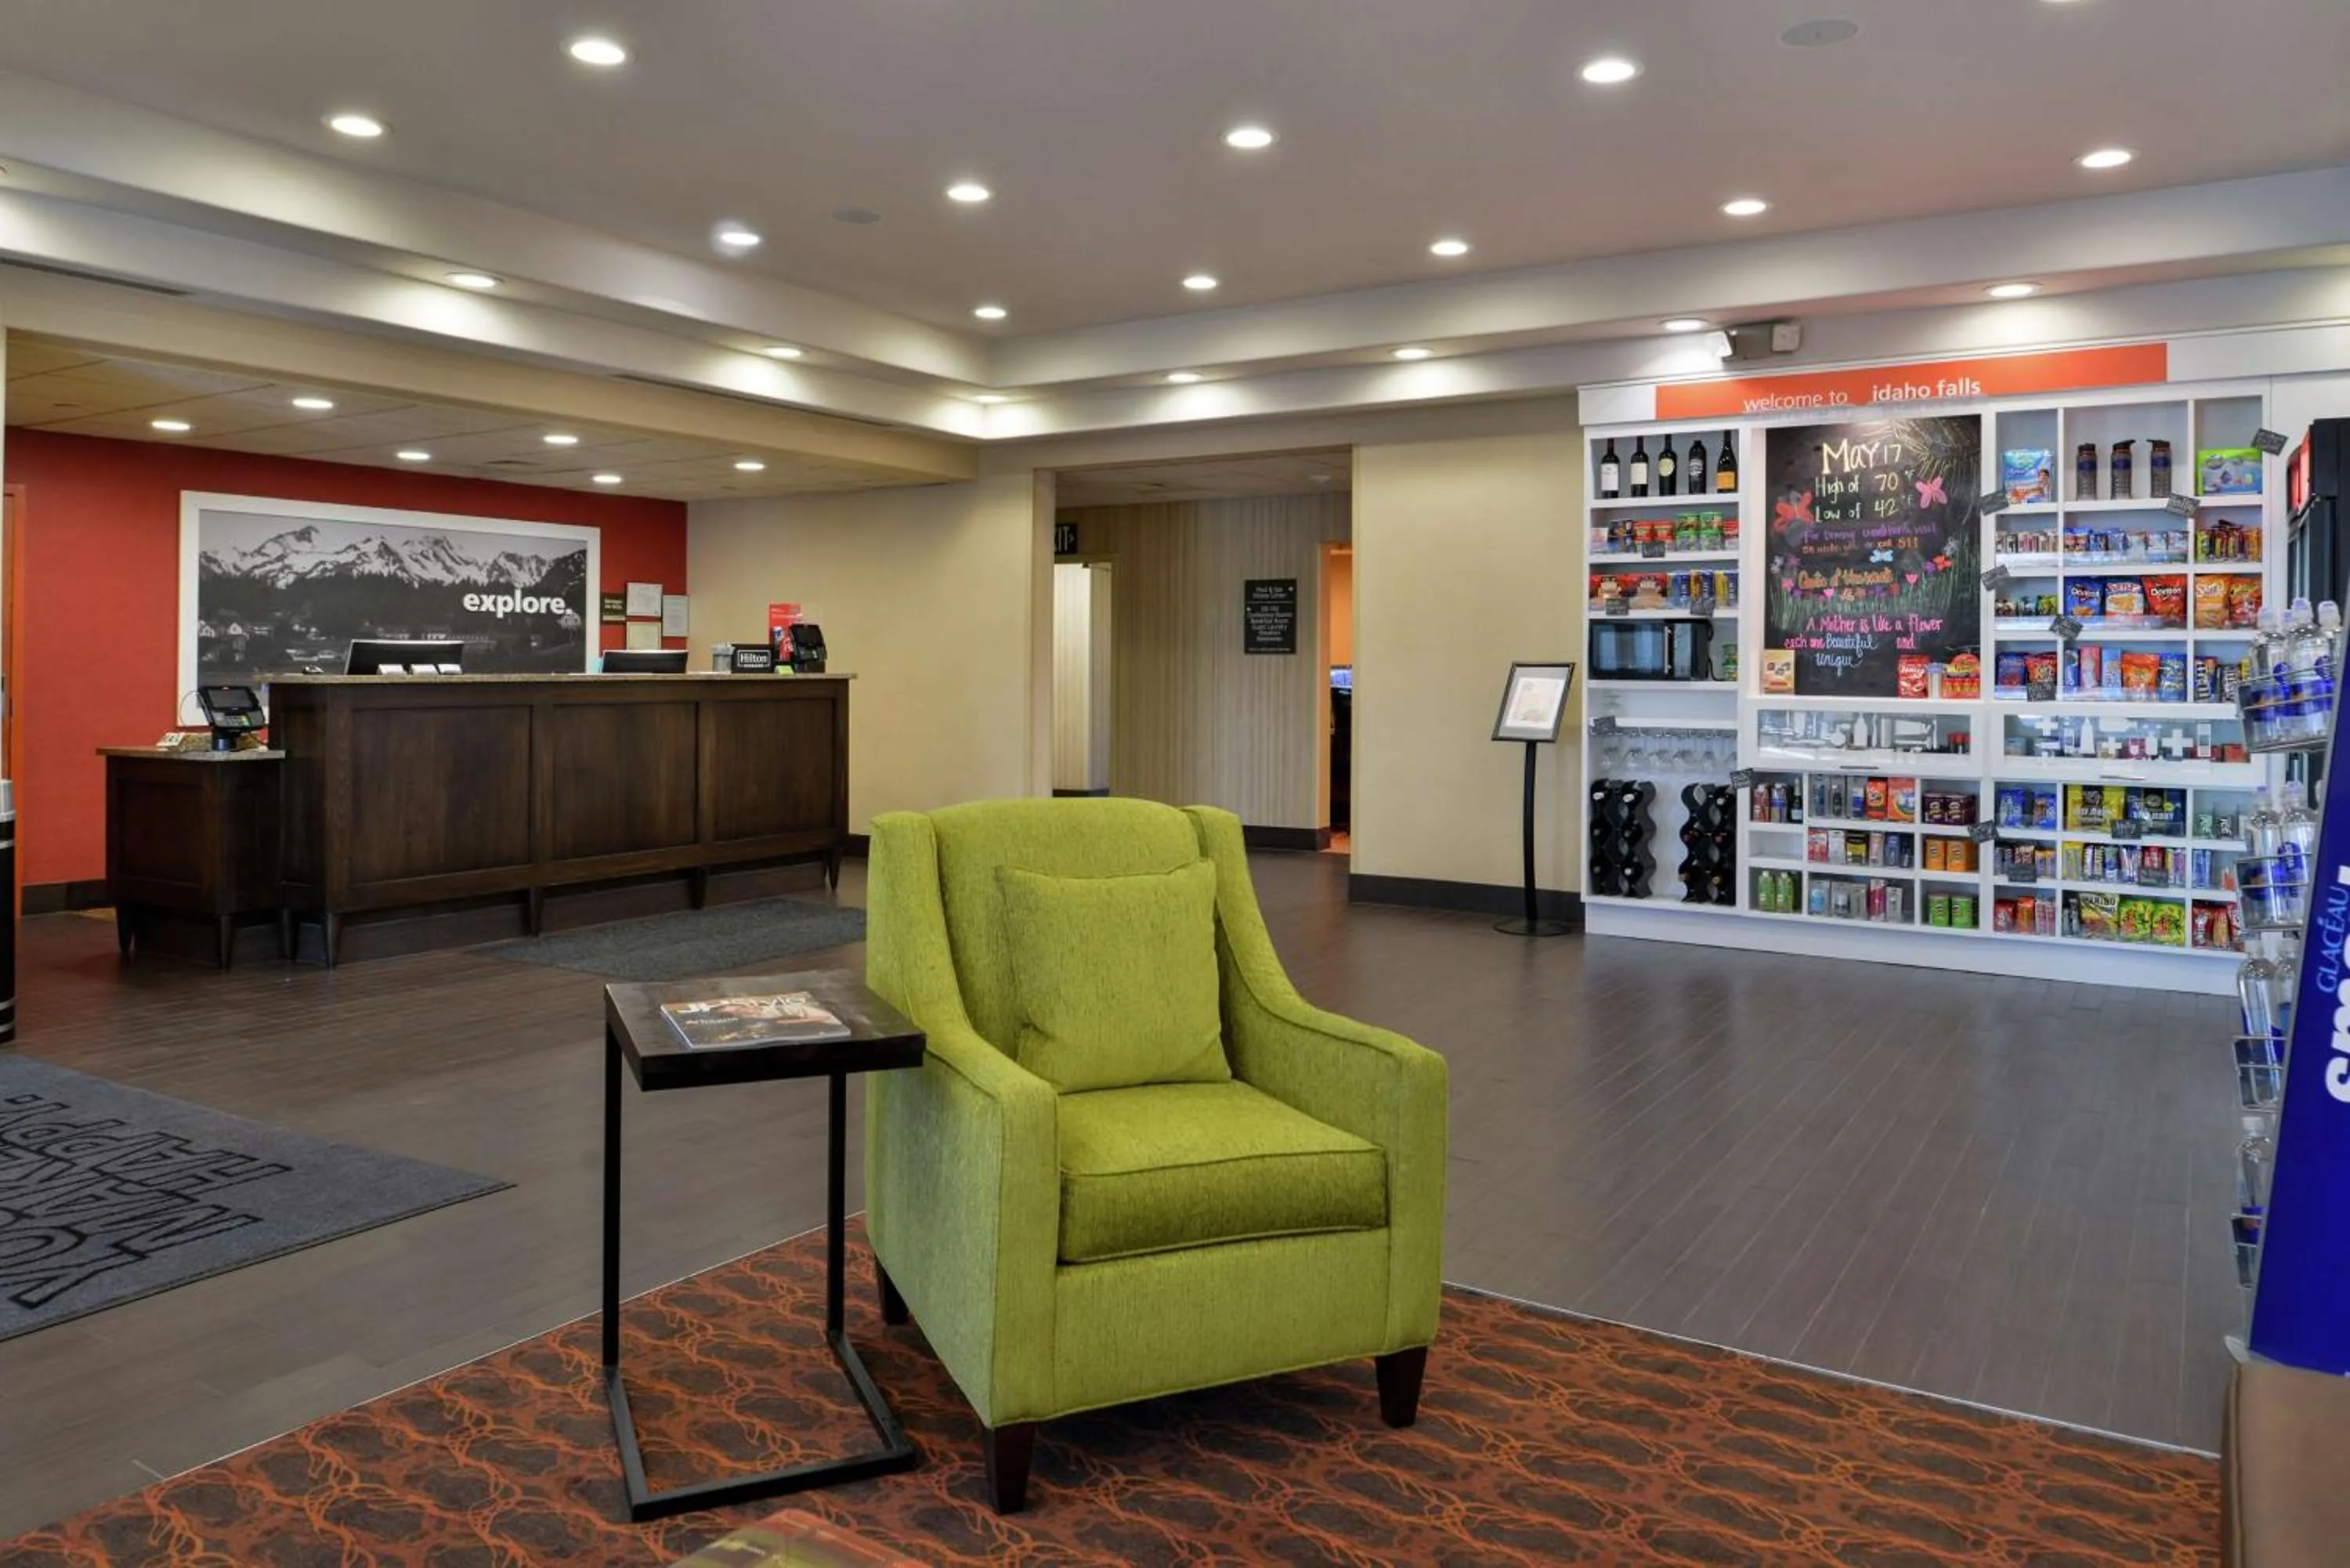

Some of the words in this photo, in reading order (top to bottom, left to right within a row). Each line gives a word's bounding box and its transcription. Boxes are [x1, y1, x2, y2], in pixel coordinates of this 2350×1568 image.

[1743, 390, 1823, 412] welcome
[1829, 390, 1848, 406] to
[1872, 382, 1931, 402] idaho
[1936, 378, 1981, 398] falls
[1883, 444, 1901, 464] 17
[1815, 475, 1845, 504] High
[1848, 474, 1860, 493] of
[1874, 471, 1898, 492] 70
[1815, 505, 1840, 523] Low
[1848, 502, 1861, 519] of
[1874, 497, 1899, 518] 42
[463, 589, 573, 619] explore.
[740, 651, 767, 664] Hilton
[2316, 886, 2349, 993] GLACÉAU
